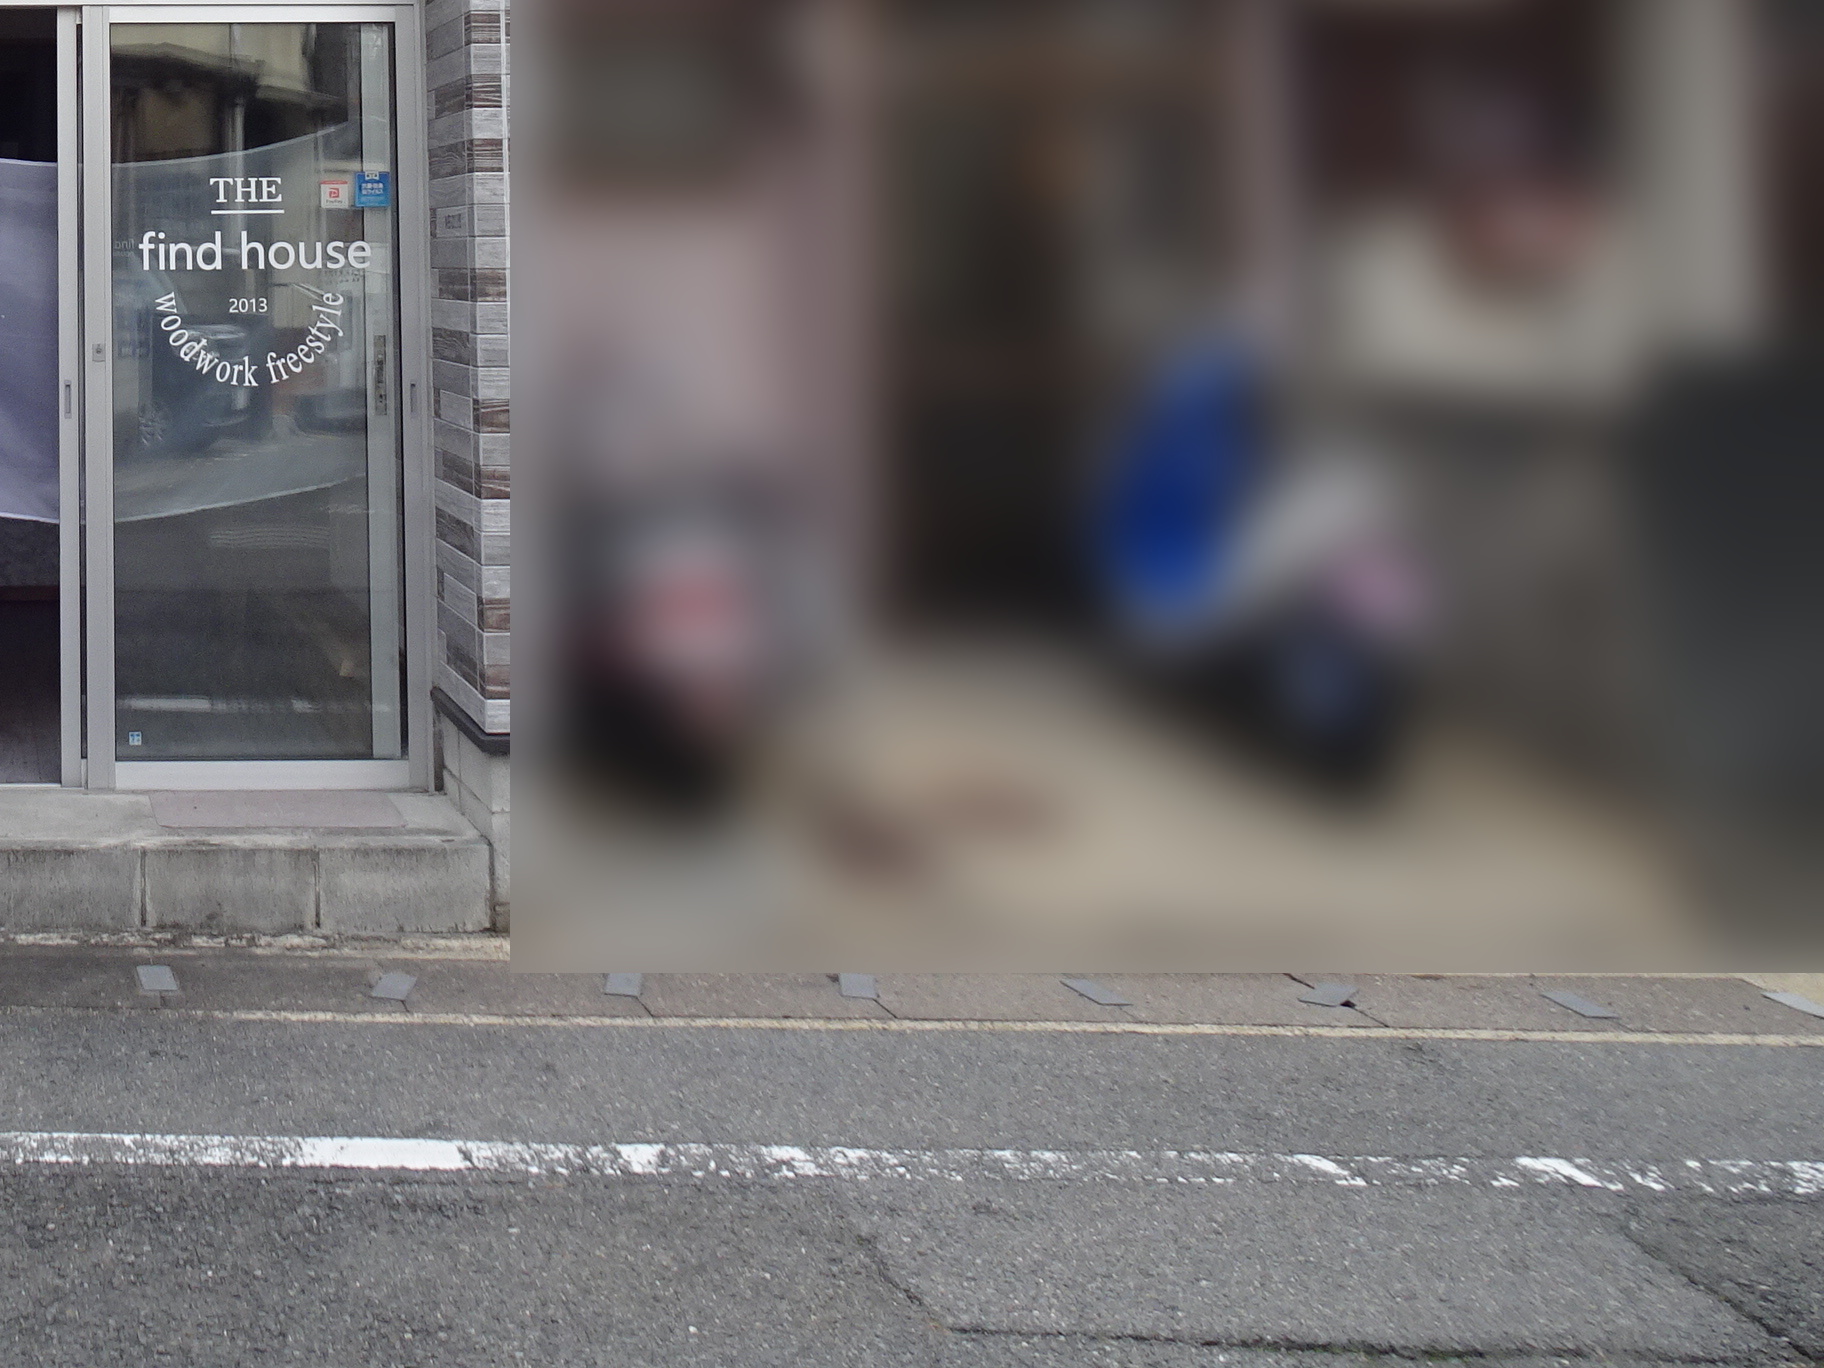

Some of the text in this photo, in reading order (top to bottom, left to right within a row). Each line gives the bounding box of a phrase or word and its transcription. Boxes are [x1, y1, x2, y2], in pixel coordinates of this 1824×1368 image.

[210, 177, 282, 203] THE
[138, 231, 372, 271] find house
[229, 298, 268, 313] 2013
[155, 291, 344, 387] woodwork freestyle
